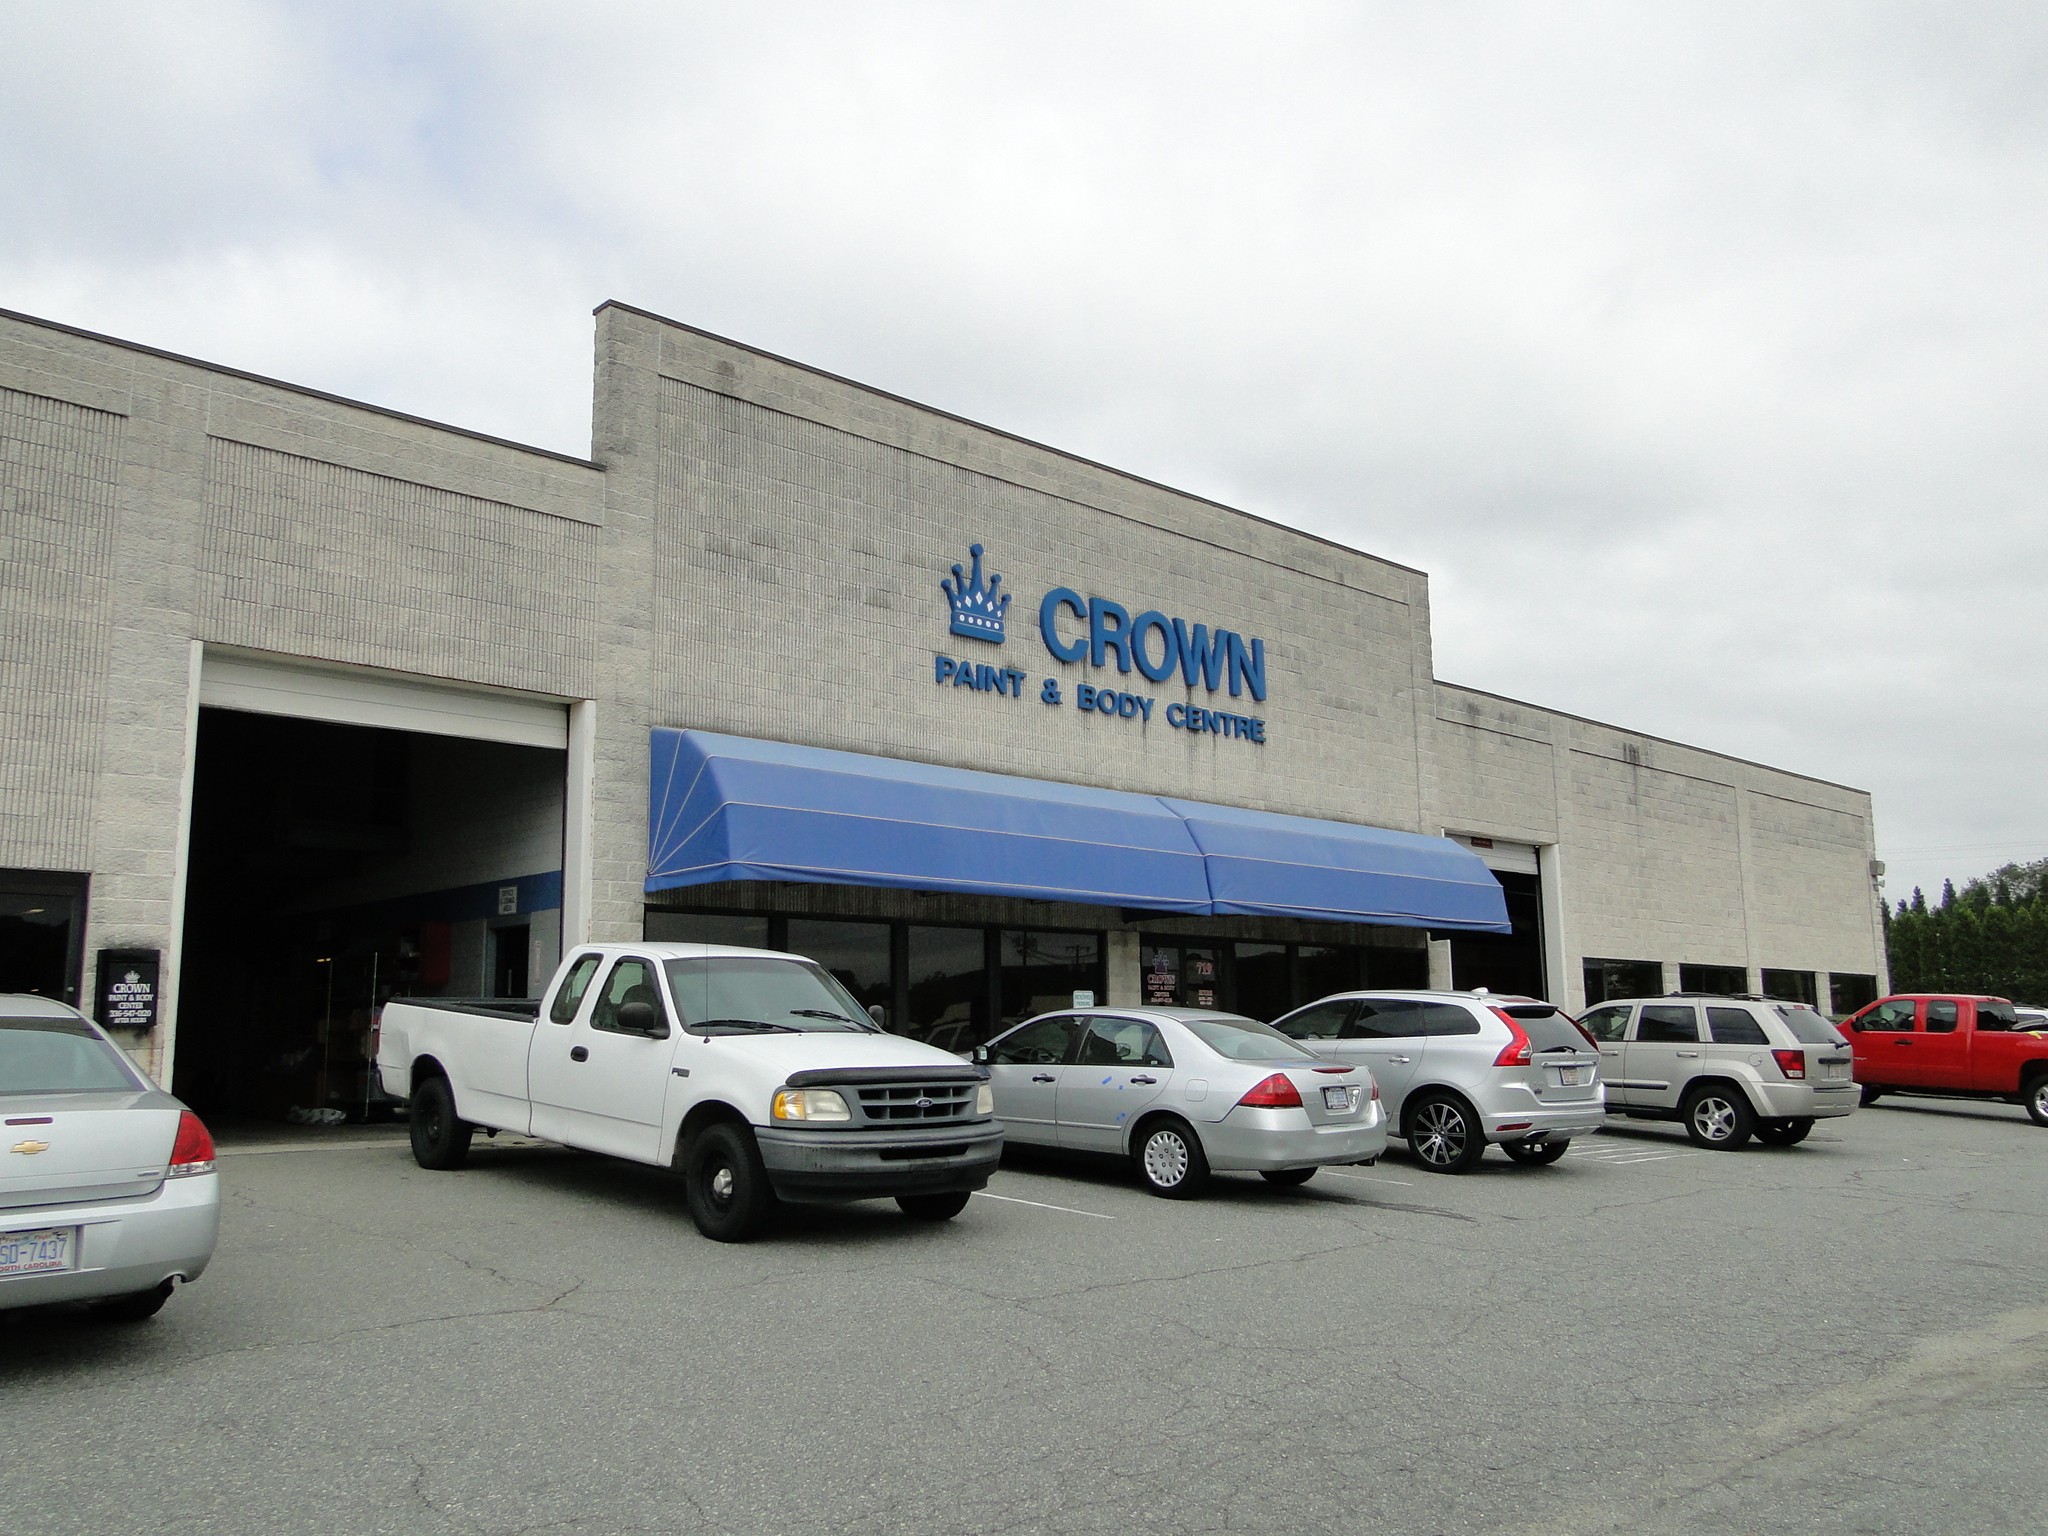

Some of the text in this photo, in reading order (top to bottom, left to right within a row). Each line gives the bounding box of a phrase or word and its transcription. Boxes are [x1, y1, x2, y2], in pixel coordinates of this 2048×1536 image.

[1040, 587, 1266, 701] CROWN
[935, 656, 1266, 743] PAINT & BODY CENTRE
[1147, 974, 1175, 984] CROWN
[113, 983, 151, 993] CROWN
[23, 1260, 63, 1270] CAROLINA
